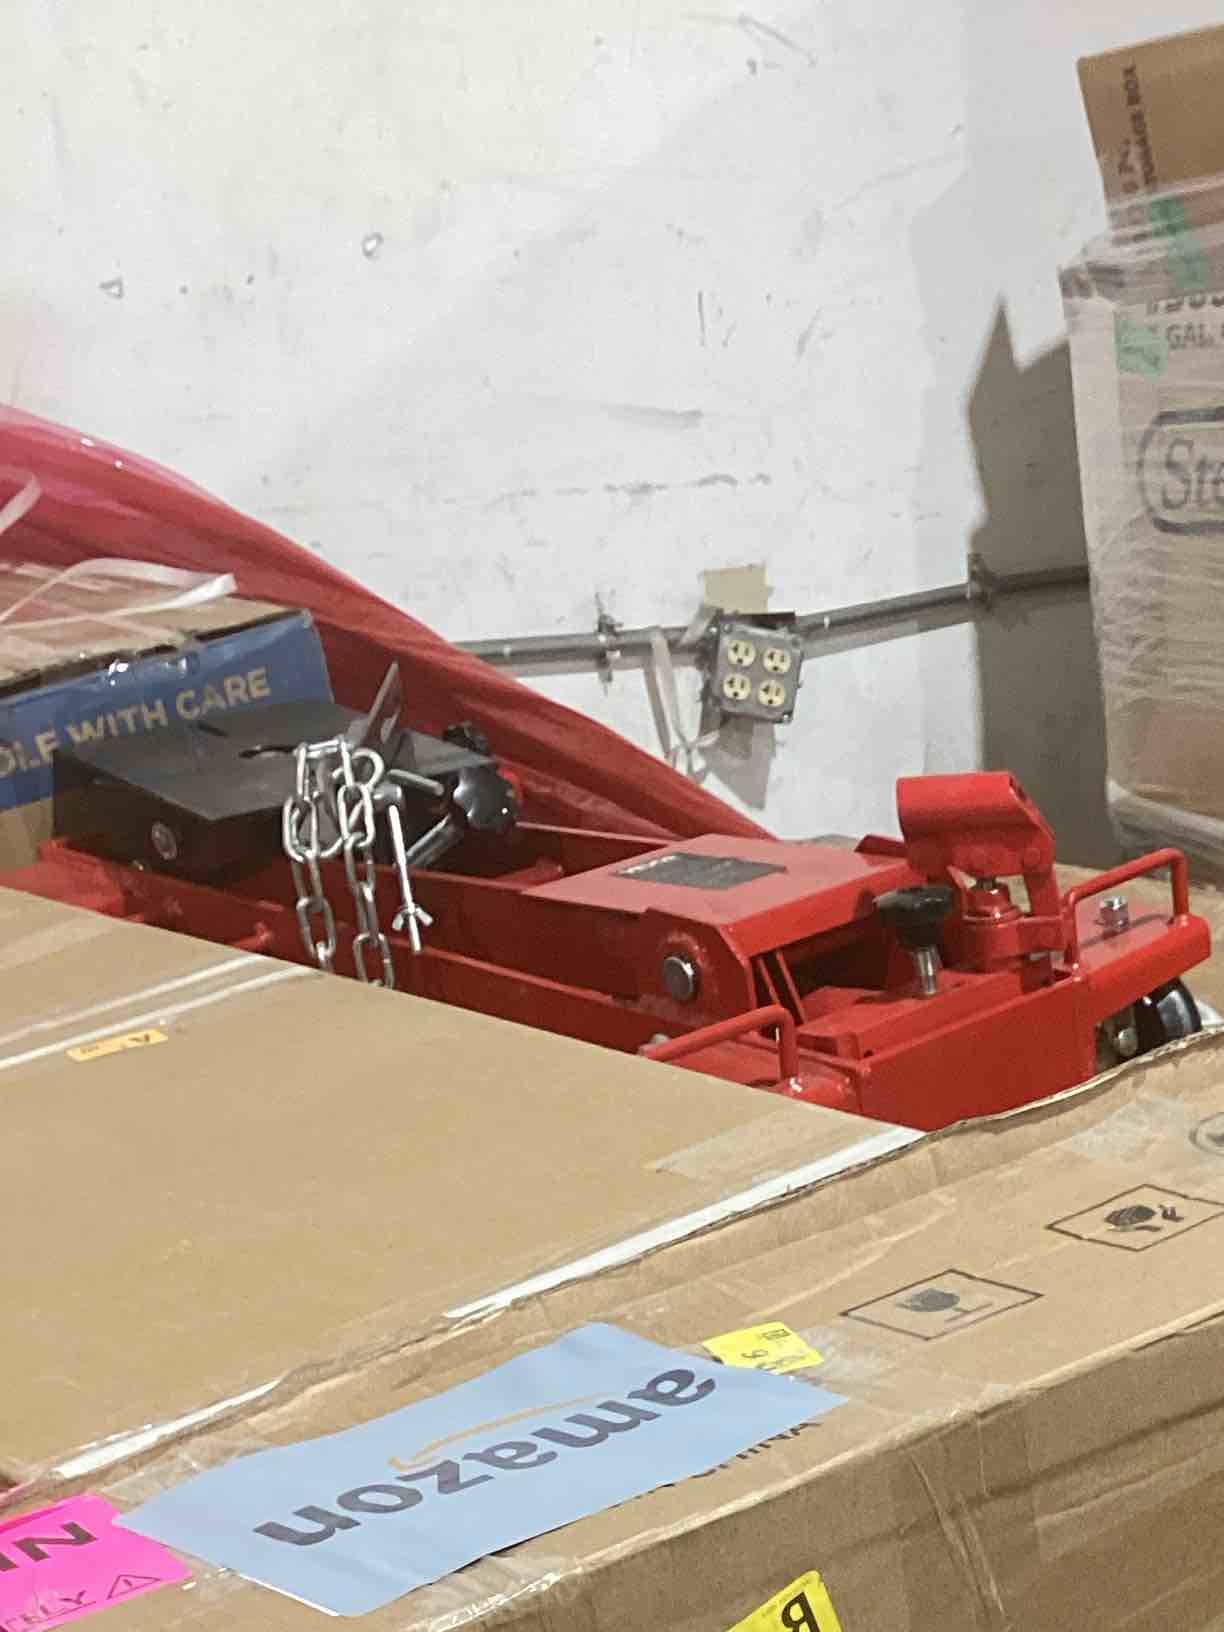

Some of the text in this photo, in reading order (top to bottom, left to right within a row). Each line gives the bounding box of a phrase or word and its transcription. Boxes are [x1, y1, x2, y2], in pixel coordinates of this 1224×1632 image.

[66, 700, 169, 745] WITH
[175, 666, 272, 721] CARE
[253, 1366, 719, 1548] amazon
